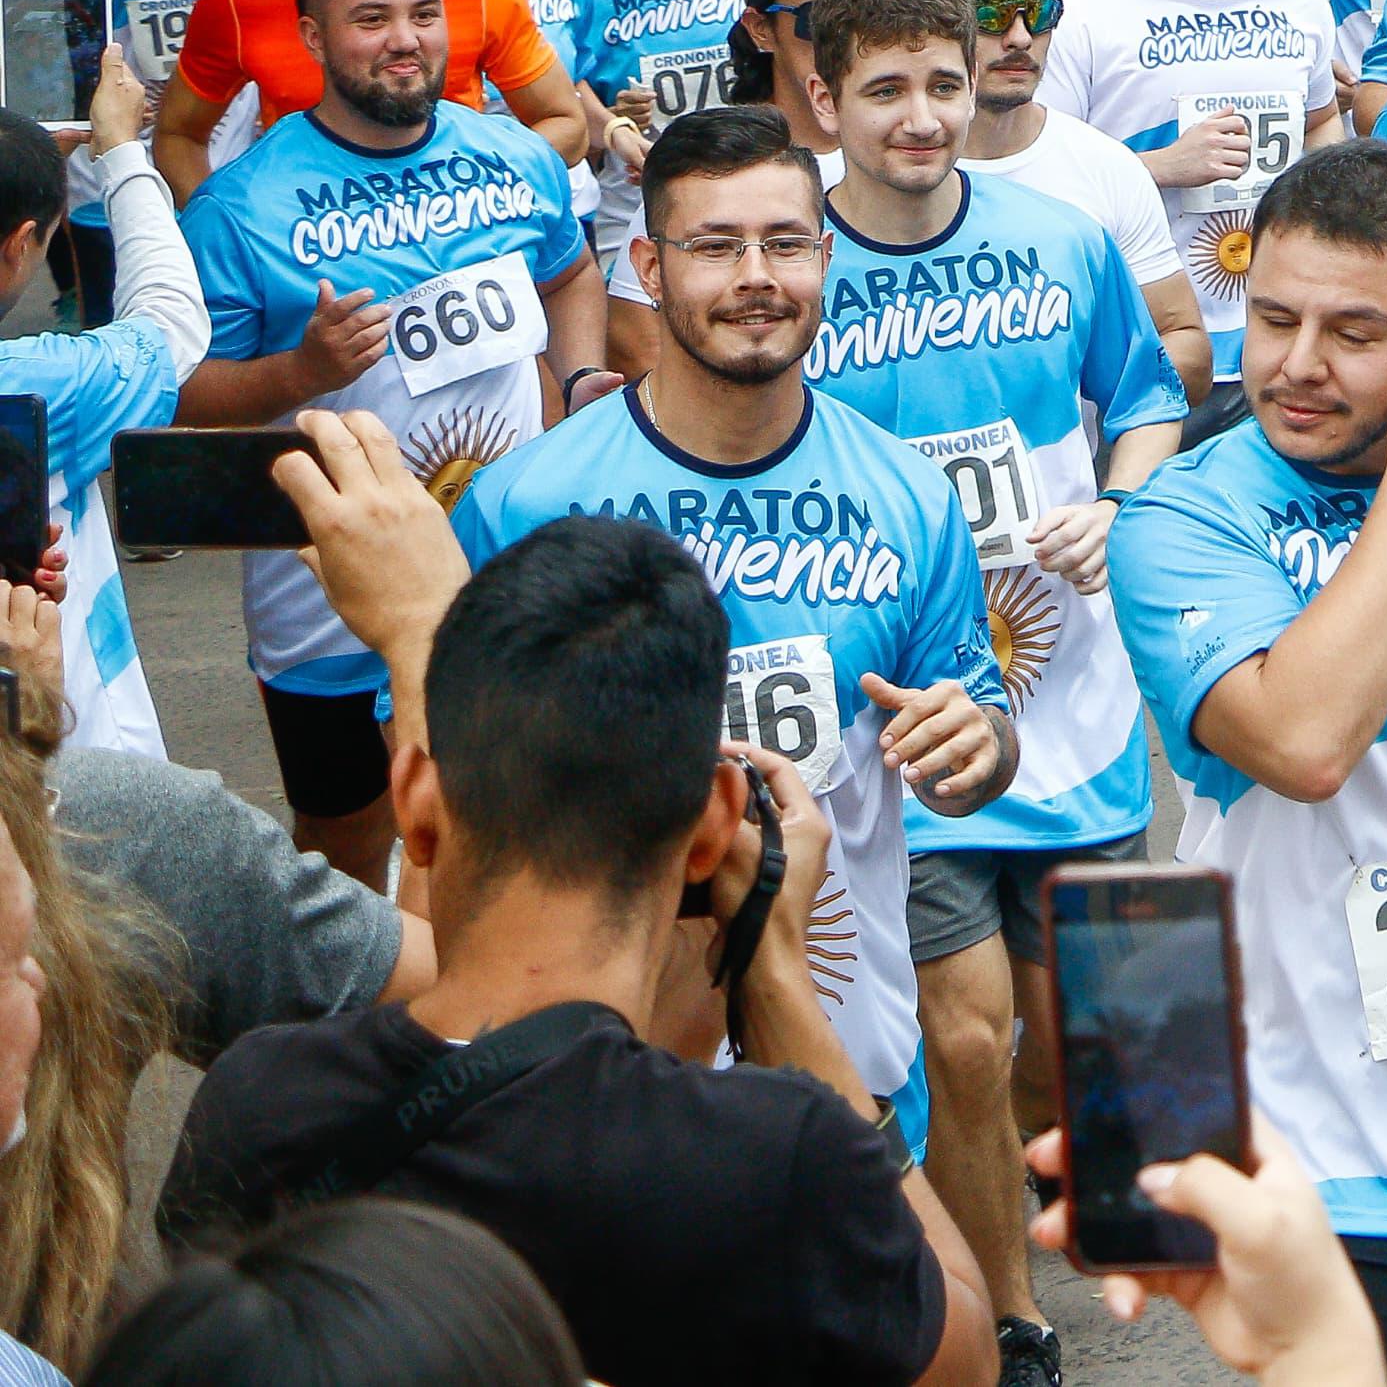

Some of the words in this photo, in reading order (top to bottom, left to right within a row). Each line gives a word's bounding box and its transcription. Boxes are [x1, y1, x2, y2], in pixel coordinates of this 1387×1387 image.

[141, 13, 194, 57] 19
[1146, 5, 1289, 37] MARATÓN
[1194, 95, 1289, 113] CRONONEA
[296, 149, 508, 217] MARATÓN
[826, 241, 1041, 318] ARATÓN
[394, 278, 516, 363] 660
[802, 270, 1073, 387] onvivencia
